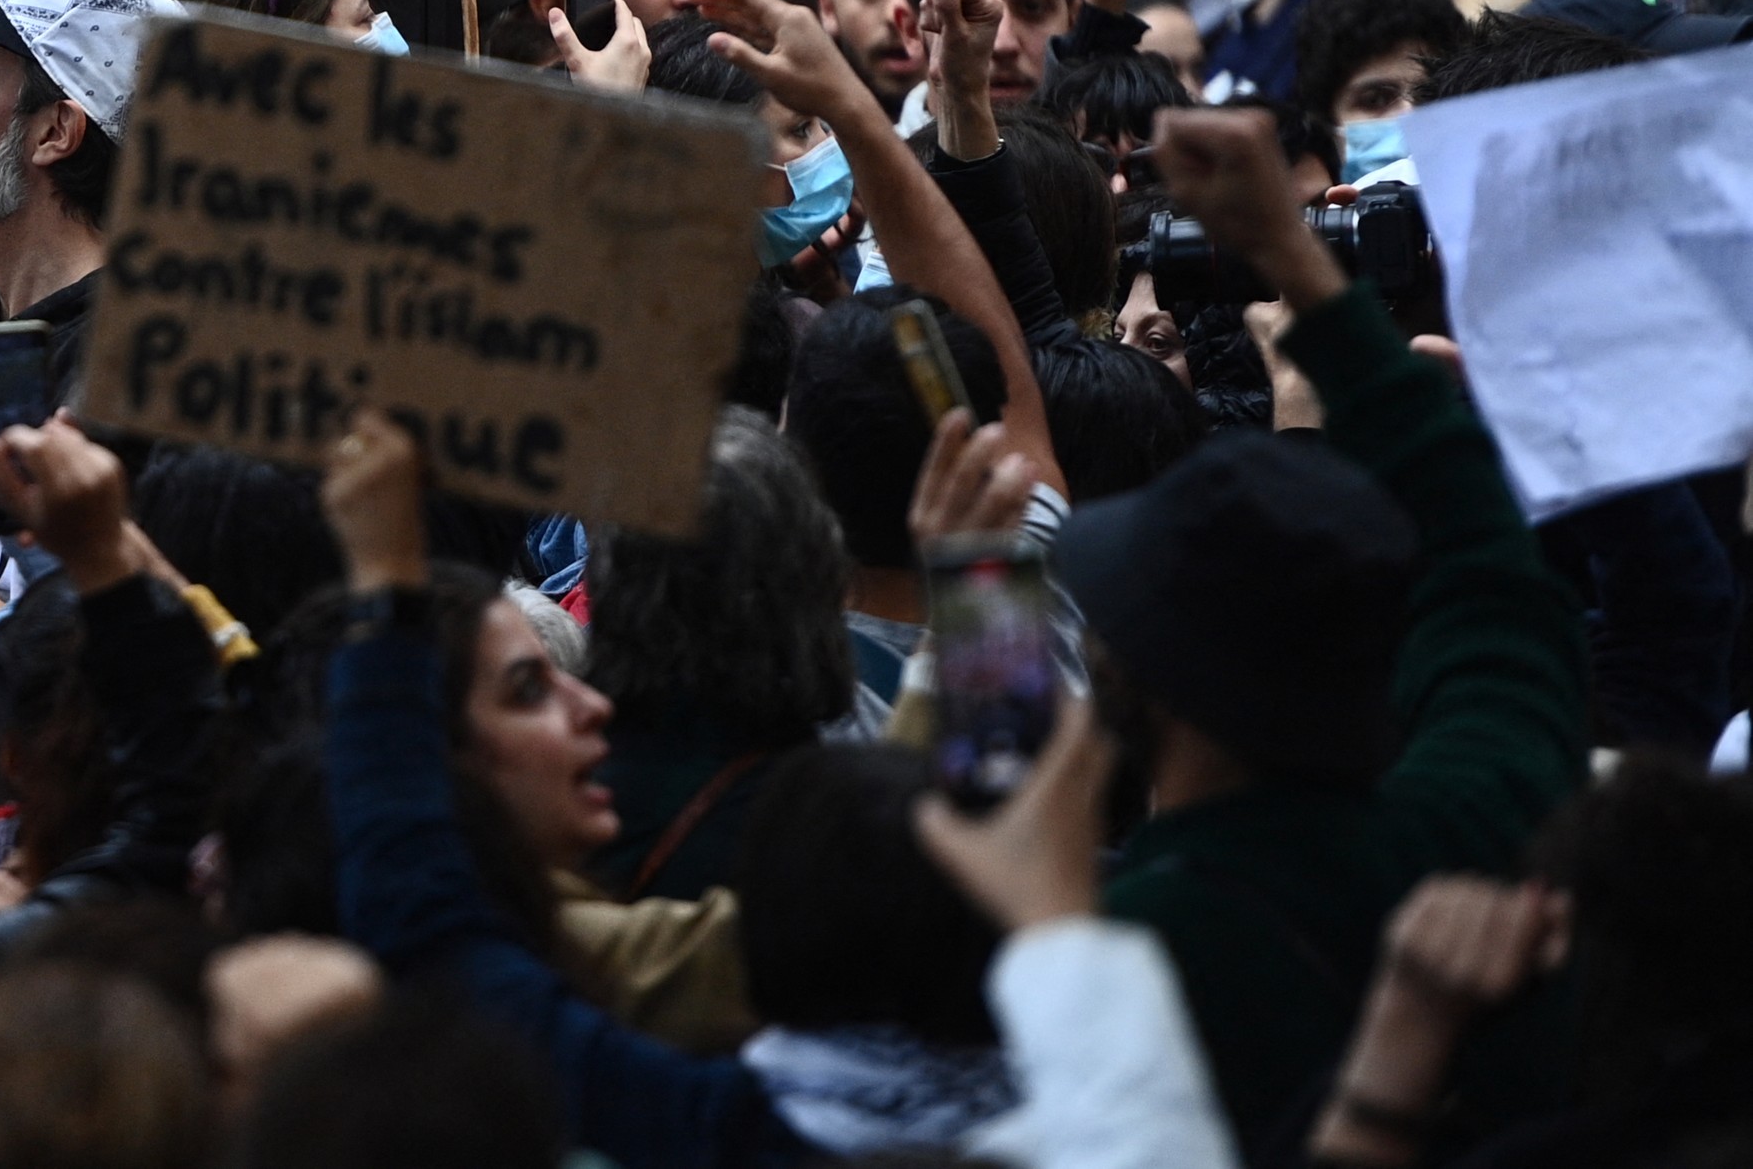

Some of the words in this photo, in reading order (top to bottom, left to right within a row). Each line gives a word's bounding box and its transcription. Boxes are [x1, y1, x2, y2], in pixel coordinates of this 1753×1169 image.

[145, 22, 336, 124] Avec
[366, 56, 465, 161] les
[126, 310, 568, 496] Politue
